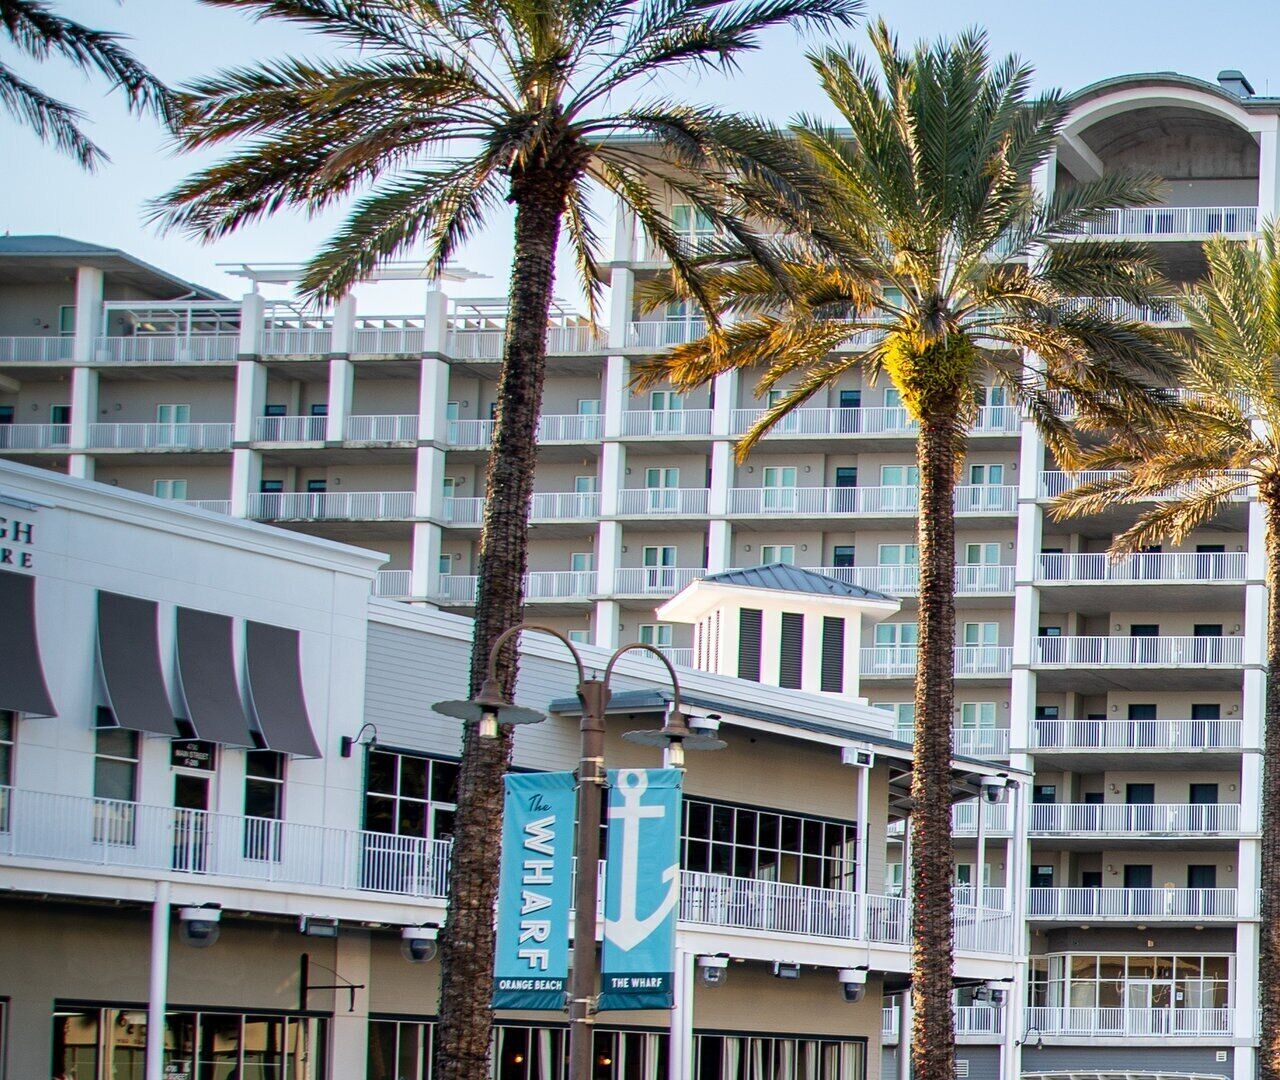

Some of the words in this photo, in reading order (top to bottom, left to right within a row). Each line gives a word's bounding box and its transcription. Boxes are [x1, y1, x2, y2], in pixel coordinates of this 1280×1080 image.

[529, 794, 551, 812] The
[517, 815, 556, 971] WHARF
[500, 979, 533, 990] ORANGE
[534, 980, 563, 990] BEACH
[612, 977, 630, 987] THE
[631, 977, 663, 987] WHARF
